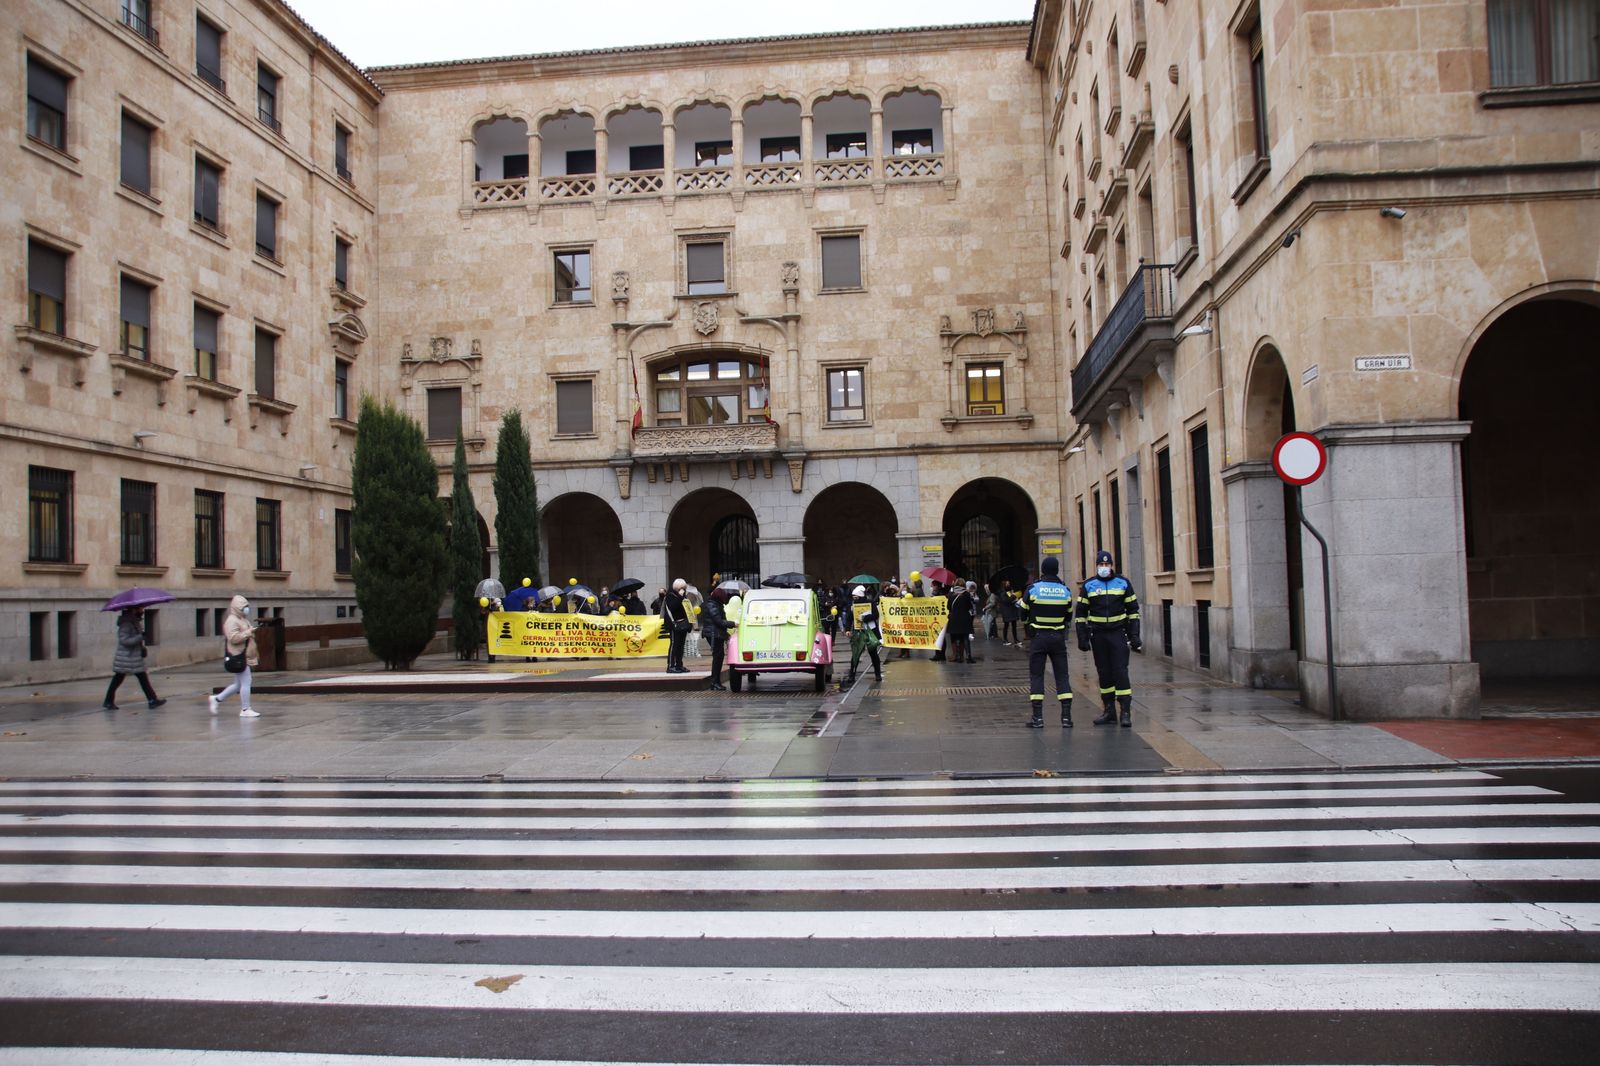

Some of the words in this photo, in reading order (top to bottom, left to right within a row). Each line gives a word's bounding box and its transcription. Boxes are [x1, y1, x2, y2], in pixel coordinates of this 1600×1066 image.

[1364, 360, 1385, 368] GRAN
[525, 621, 563, 630] CREER
[565, 622, 580, 631] EN
[582, 622, 642, 632] NOSOTROS
[891, 636, 906, 645] IVA
